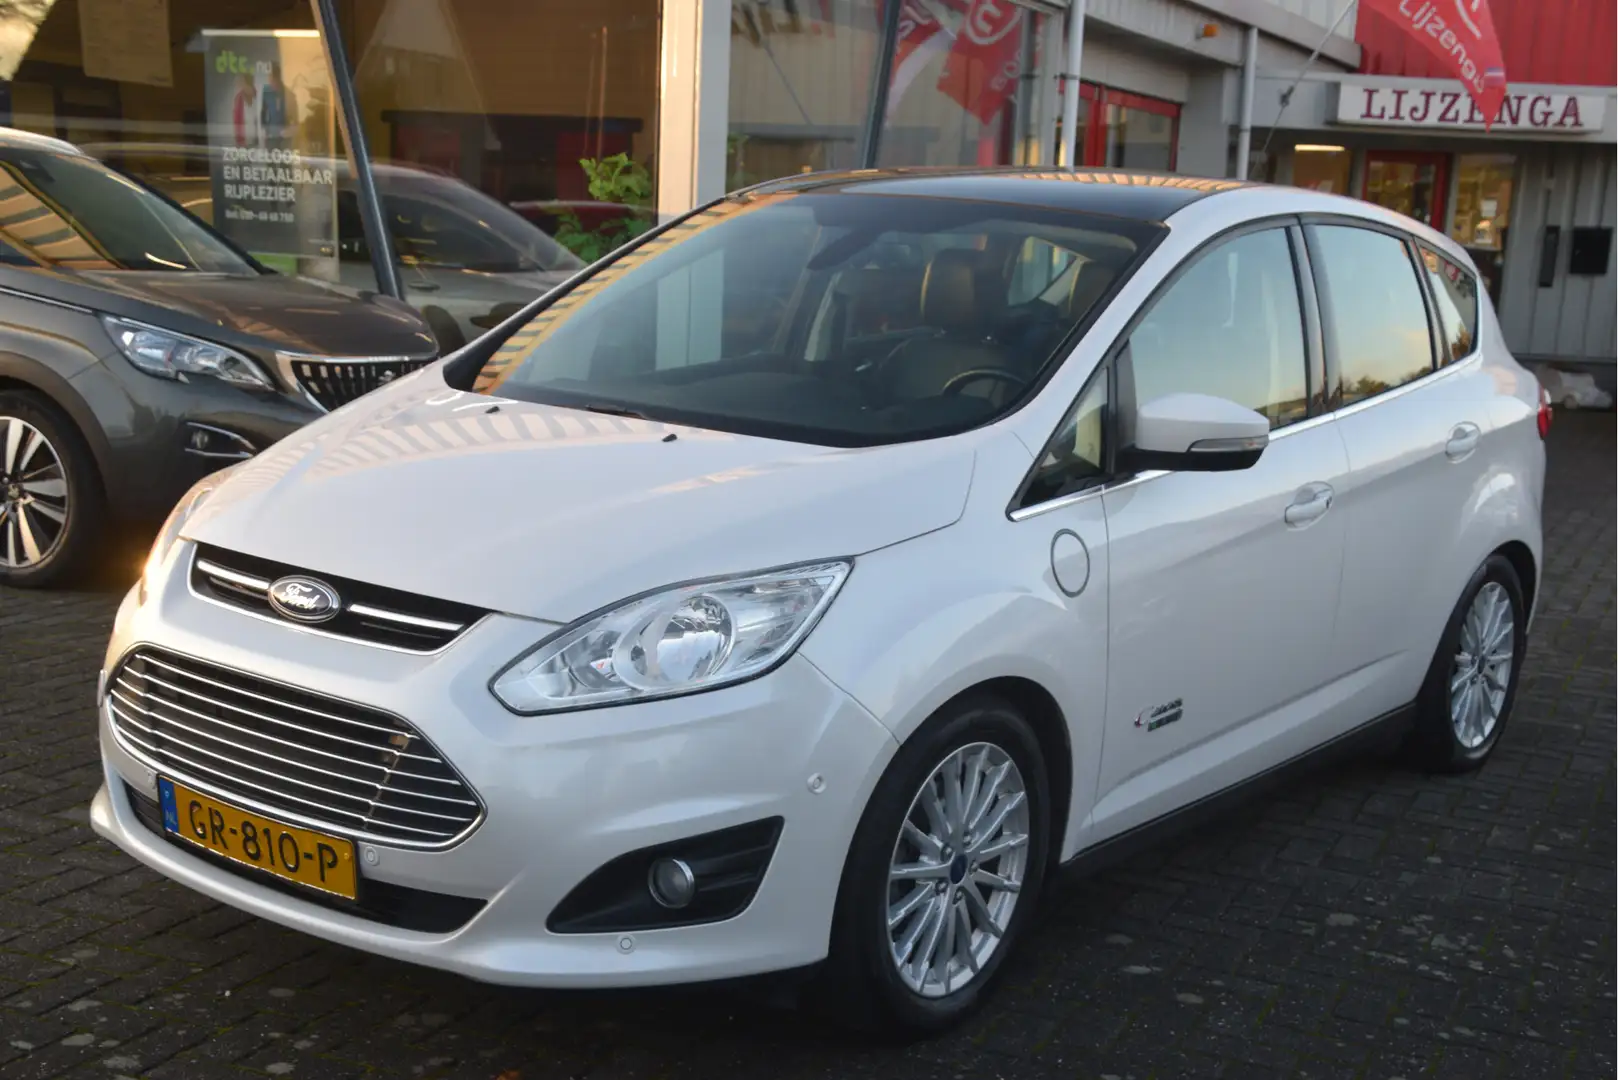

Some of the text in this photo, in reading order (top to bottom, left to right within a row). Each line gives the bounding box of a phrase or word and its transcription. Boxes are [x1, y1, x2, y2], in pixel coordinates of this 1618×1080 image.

[222, 147, 301, 165] ZORGELOOS
[223, 165, 333, 185] EN BETAALBAAR
[223, 184, 297, 202] RIJPLEZIER
[281, 583, 320, 610] Ford
[189, 800, 338, 882] GR-810-P
